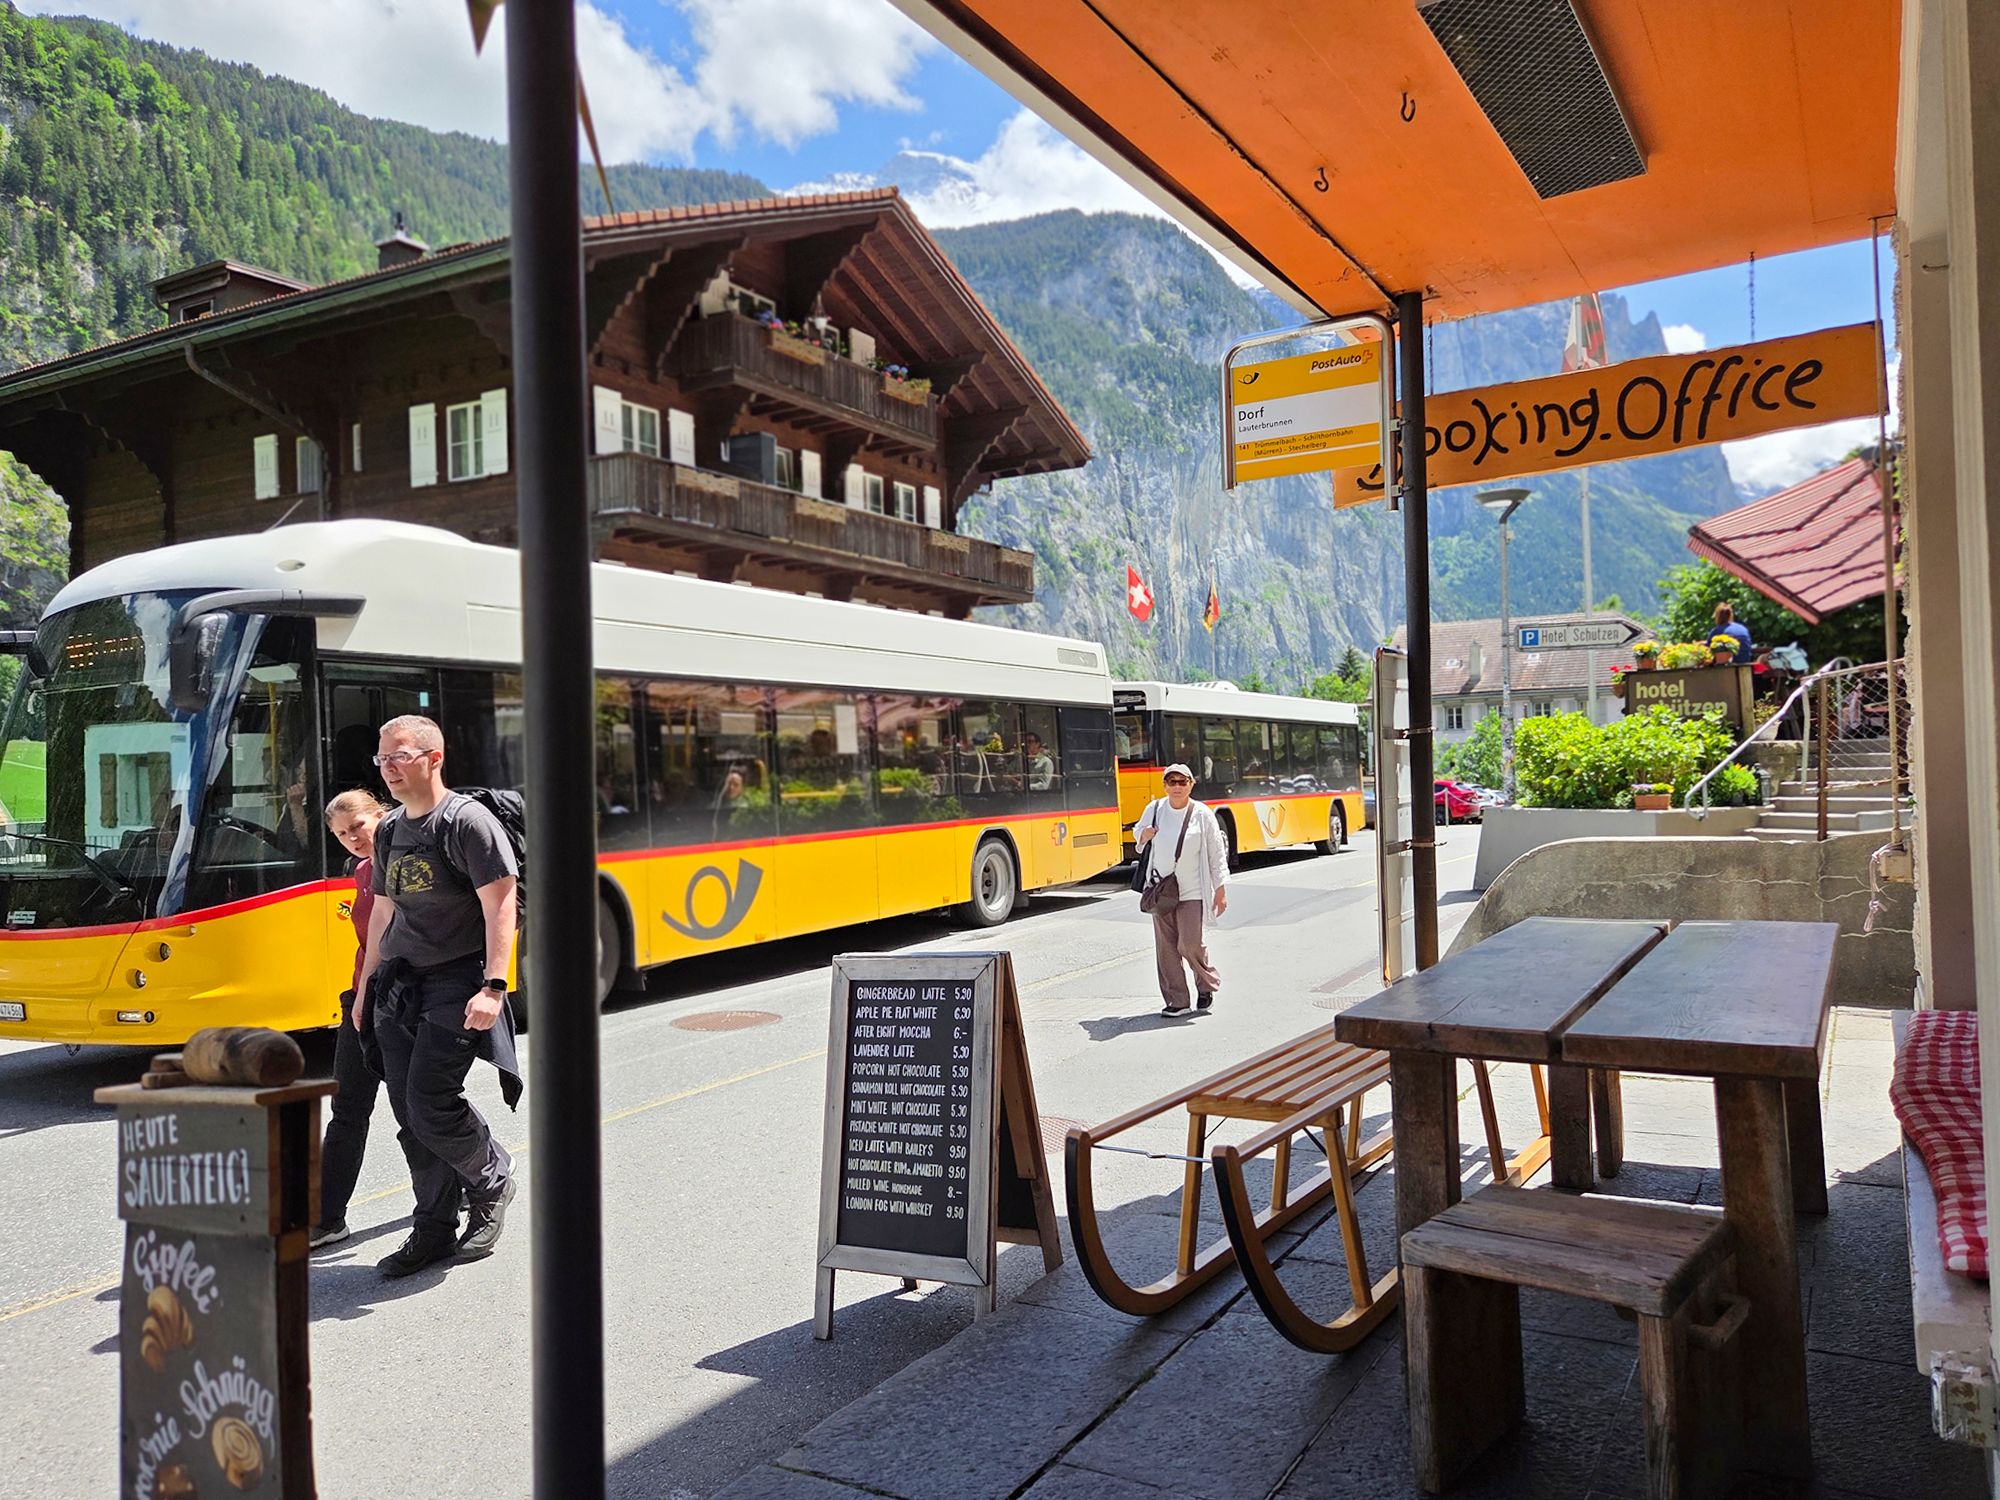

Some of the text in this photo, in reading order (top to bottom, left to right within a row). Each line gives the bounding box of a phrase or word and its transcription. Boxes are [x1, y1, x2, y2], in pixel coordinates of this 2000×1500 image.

[1311, 354, 1362, 371] PostAuto
[1238, 406, 1265, 421] Dorf
[1238, 417, 1293, 433] Lauterbrunnen
[1541, 629, 1567, 643] Hotel
[1636, 679, 1685, 699] hotel
[857, 987, 916, 1000] GINGERBREAD
[922, 987, 946, 1000] LATTE
[855, 1006, 878, 1019] APPLE
[882, 1006, 893, 1019] PIE
[895, 1006, 911, 1019] FLAT
[912, 1006, 938, 1019] WHITE
[854, 1025, 874, 1038] AFTER
[876, 1025, 896, 1038] EIGHT
[899, 1026, 931, 1039] MOCCHA
[853, 1044, 889, 1057] LAVENDER
[893, 1044, 915, 1058] LATTE
[852, 1062, 885, 1076] POPCORN
[888, 1064, 901, 1076] HOT
[902, 1064, 941, 1078] CHOCOLATE
[852, 1081, 883, 1095] CINNAMON
[885, 1082, 899, 1095] ROLL
[900, 1083, 912, 1096] HOT
[912, 1084, 946, 1097] CHOCOLATE
[850, 1100, 867, 1113] MINT
[867, 1101, 887, 1115] WHITE
[891, 1101, 905, 1115] HOT
[905, 1102, 941, 1117] CHOCOLATE
[123, 1114, 178, 1153] HEUTE
[849, 1120, 877, 1134] PISTACHE
[877, 1121, 897, 1134] WHITE
[899, 1122, 911, 1136] HOT
[911, 1123, 944, 1137] CHOCOLATE
[849, 1139, 864, 1152] ICED
[865, 1139, 885, 1154] LATTE
[885, 1141, 903, 1154] WITH
[848, 1158, 860, 1171] HOT
[860, 1158, 892, 1173] CHOCOLATE
[912, 1162, 943, 1178] AMARETTO
[124, 1149, 250, 1207] SAUERTEIG!
[847, 1177, 871, 1191] MULLED
[873, 1179, 889, 1193] WINE
[846, 1195, 873, 1211] LONDON
[874, 1198, 888, 1212] FOG
[889, 1200, 905, 1214] WITH
[133, 1230, 218, 1314] Gipfeli
